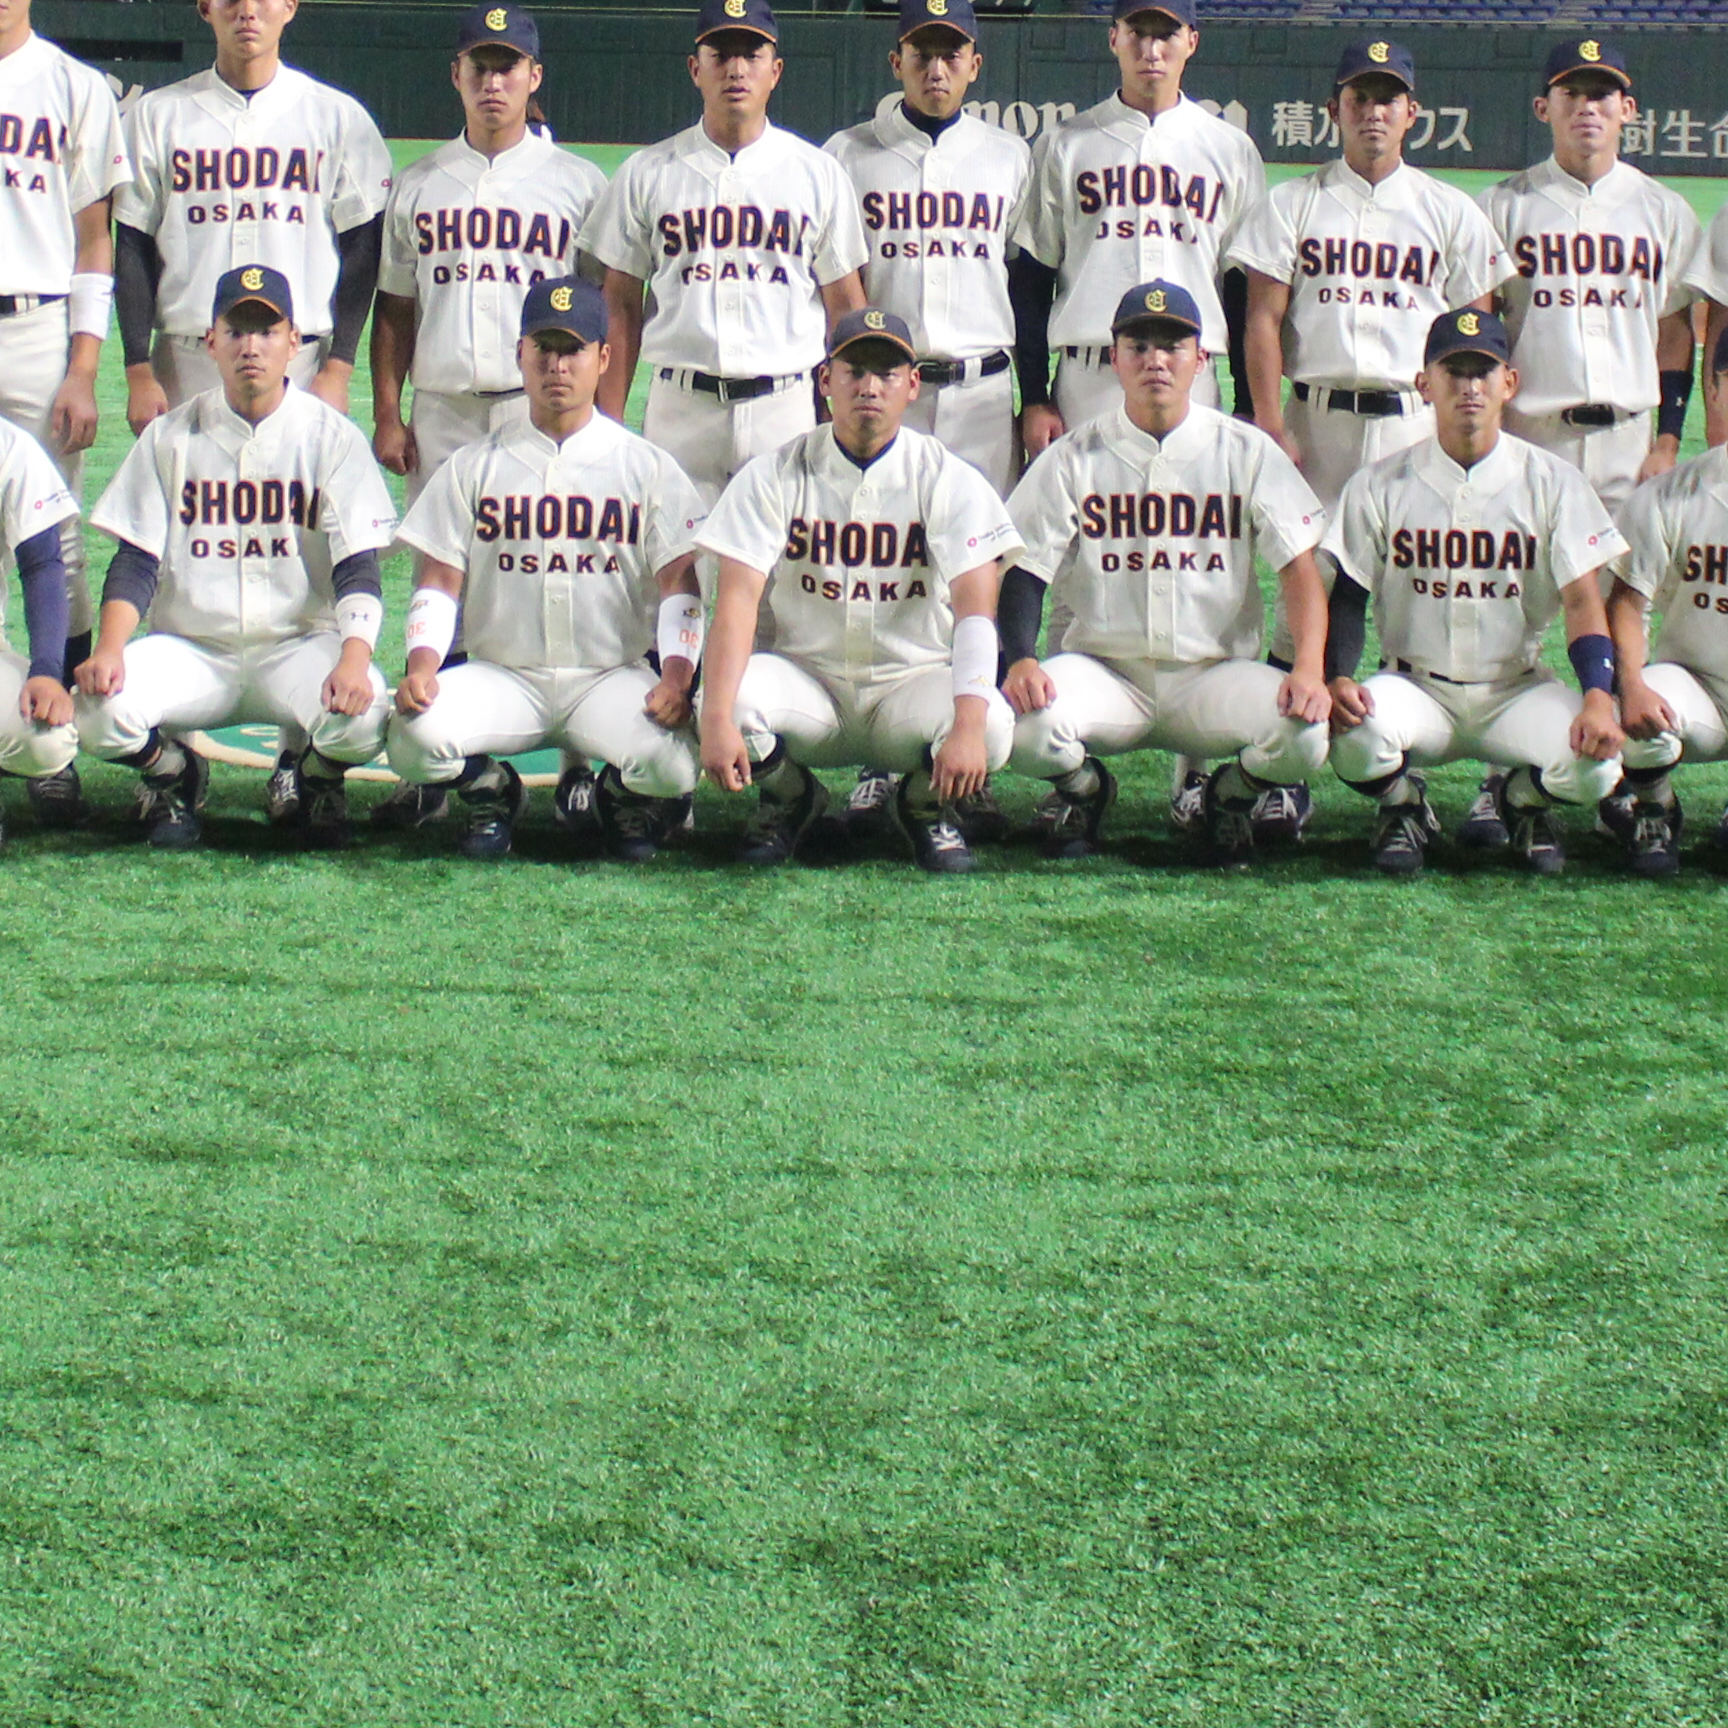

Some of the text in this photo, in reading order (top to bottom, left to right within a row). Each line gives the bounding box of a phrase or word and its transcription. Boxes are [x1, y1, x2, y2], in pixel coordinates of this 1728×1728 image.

[171, 147, 324, 194] SHODAI
[187, 201, 306, 226] OSAKA
[863, 191, 1006, 231] SHODAI
[1076, 164, 1225, 225] SHODAI
[415, 207, 571, 262] SHODAI
[657, 204, 811, 258] SHODAI
[880, 240, 992, 261] OSAKA
[1300, 236, 1441, 286] SHODAI
[1516, 233, 1664, 282] SHODAI
[1318, 286, 1422, 312] OSAKA
[178, 478, 321, 531] SHODAI
[475, 494, 640, 545] SHODAI
[1081, 492, 1242, 541] SHODAI
[497, 551, 623, 576] OSAKA
[1101, 550, 1227, 574] OSAKA
[1393, 528, 1537, 572] SHODAI
[800, 573, 929, 603] OSAKA
[1411, 577, 1521, 600] OSAKA
